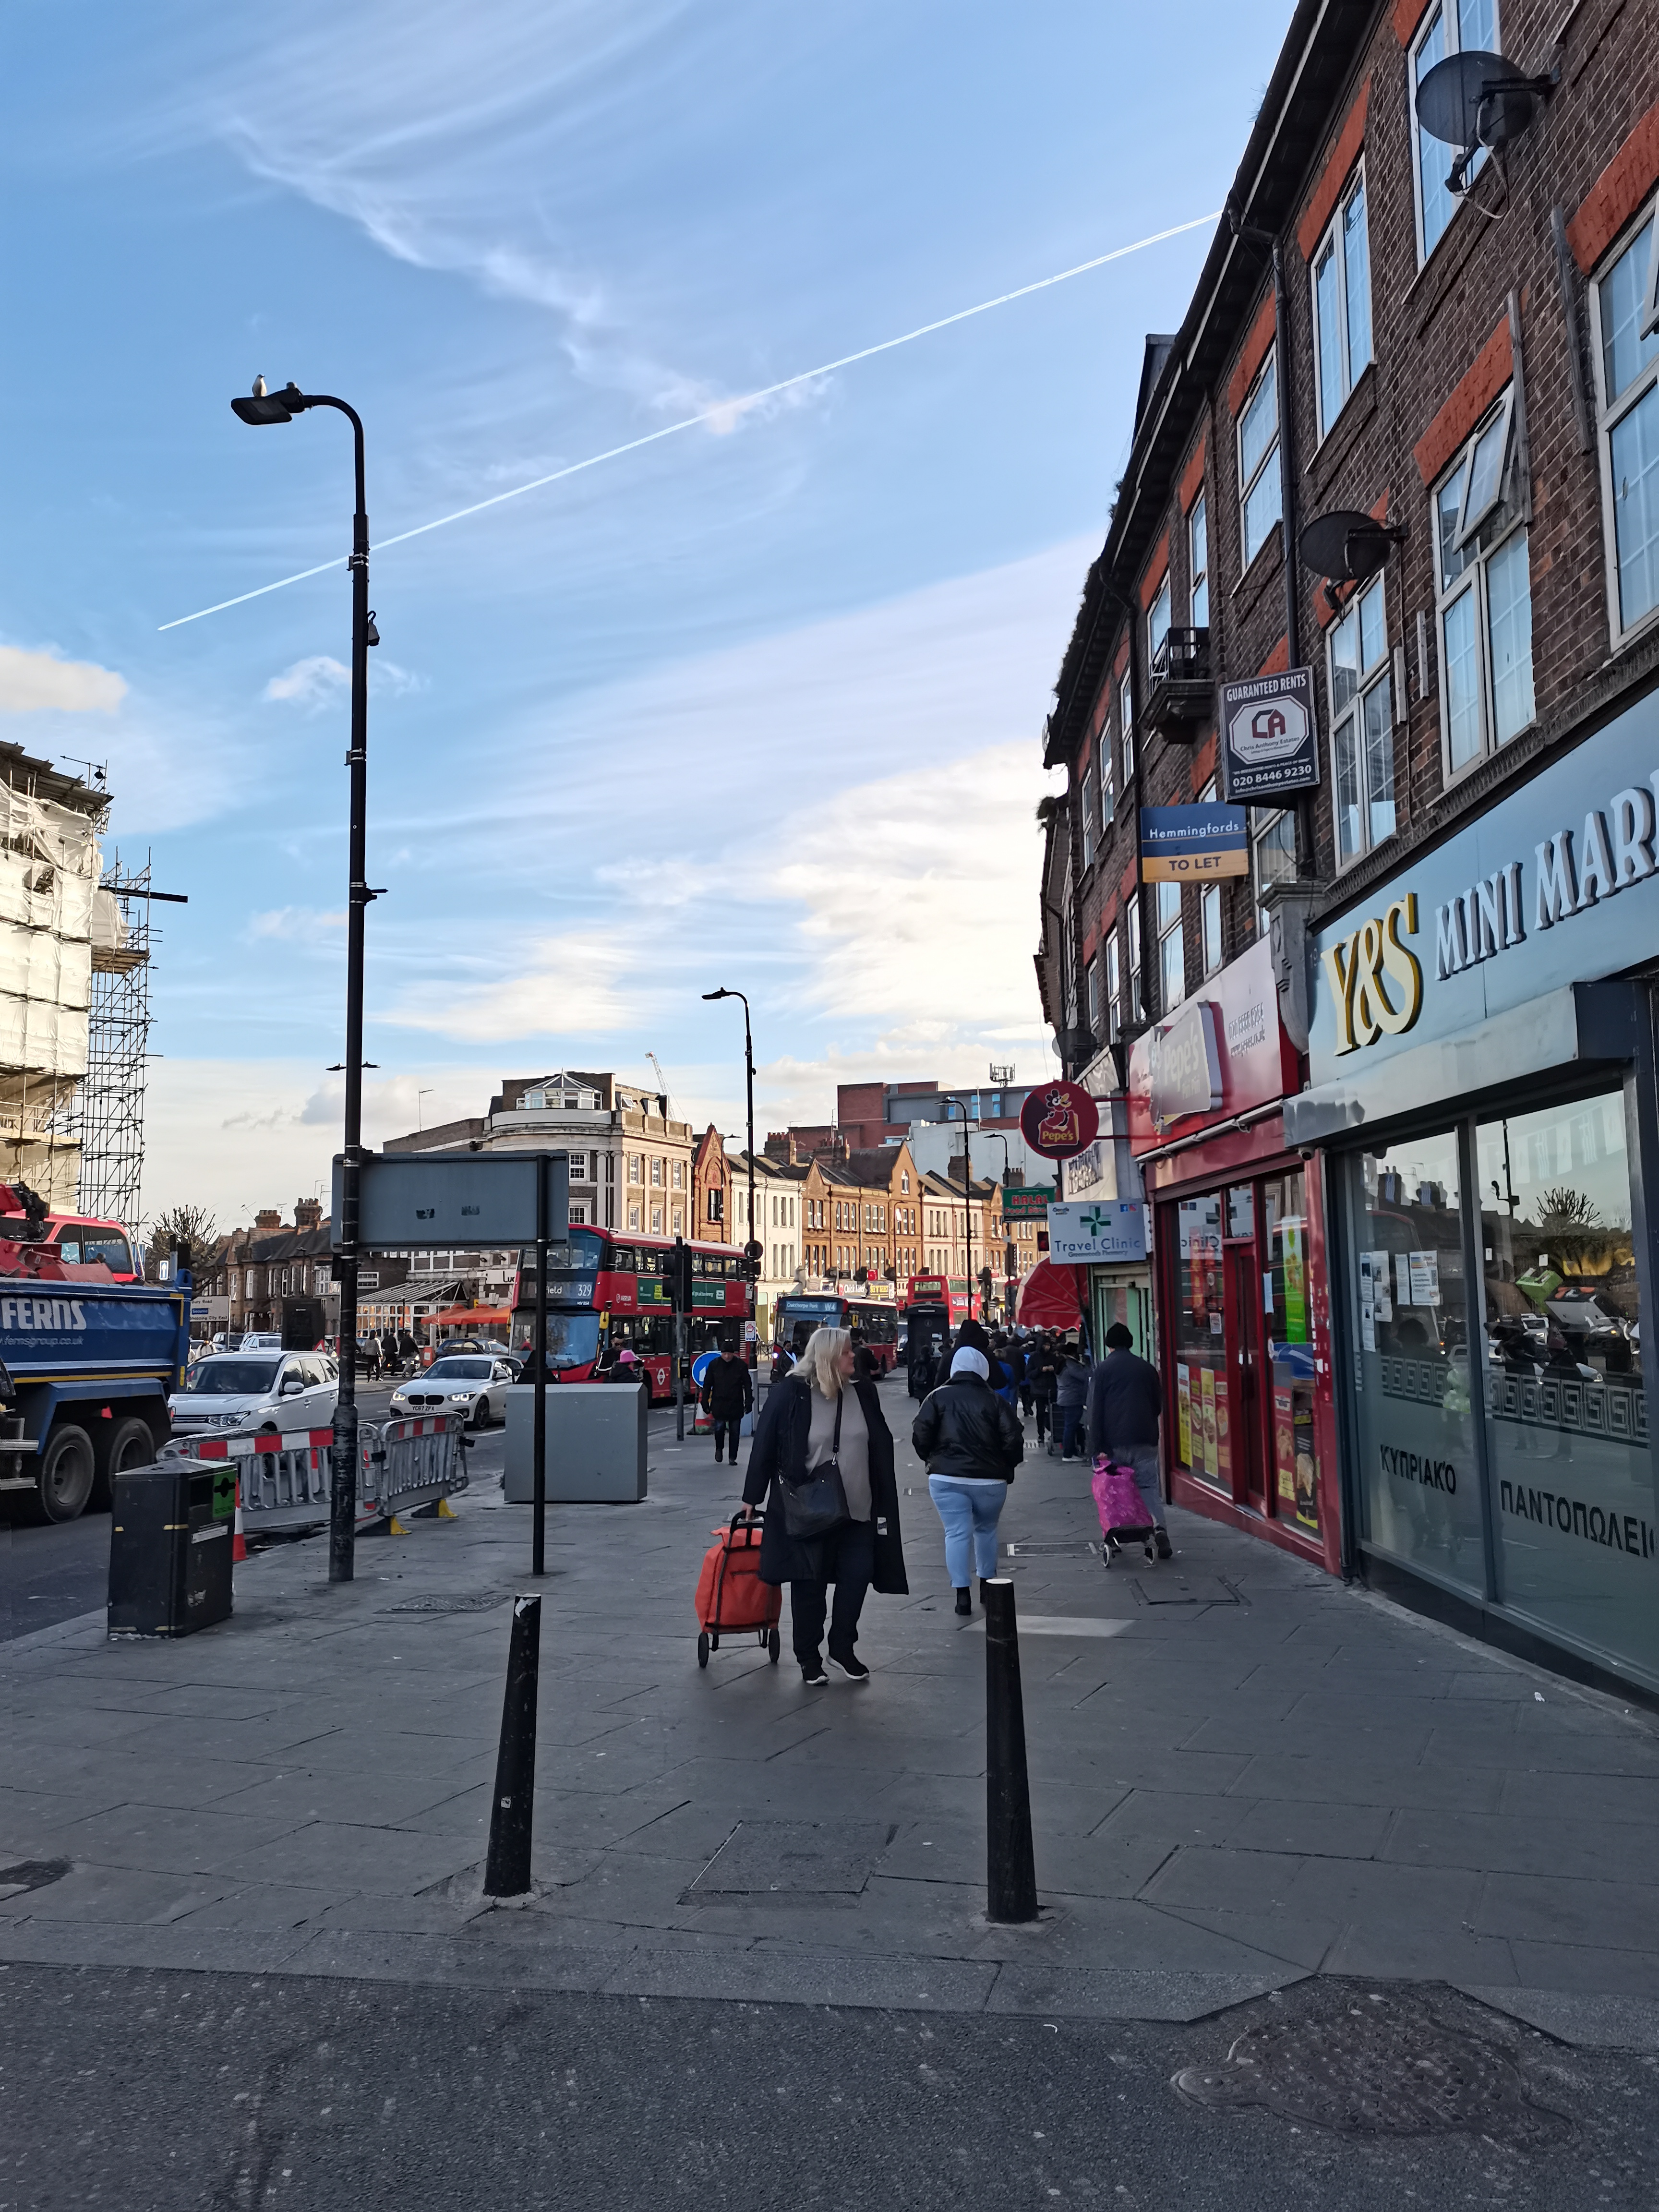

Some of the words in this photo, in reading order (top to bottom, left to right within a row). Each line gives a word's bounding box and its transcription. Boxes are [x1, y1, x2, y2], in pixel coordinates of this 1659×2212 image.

[1227, 680, 1279, 701] GUARANTEED
[1280, 673, 1306, 691] RENTS
[1255, 740, 1279, 749] Anthony
[1233, 775, 1253, 787] 020
[1255, 770, 1282, 783] 8446
[1284, 765, 1312, 778] 9230
[1150, 820, 1239, 839] Hemmingfords
[1169, 860, 1190, 871] TO
[1195, 856, 1222, 869] LET
[1435, 861, 1527, 980] MINI
[1164, 1022, 1199, 1092] Pepe's
[1042, 1130, 1074, 1142] Pepe's
[1012, 1194, 1049, 1205] HALAL
[1055, 1238, 1096, 1252] Travel
[1101, 1237, 1141, 1250] Clinic
[577, 1284, 592, 1296] 329
